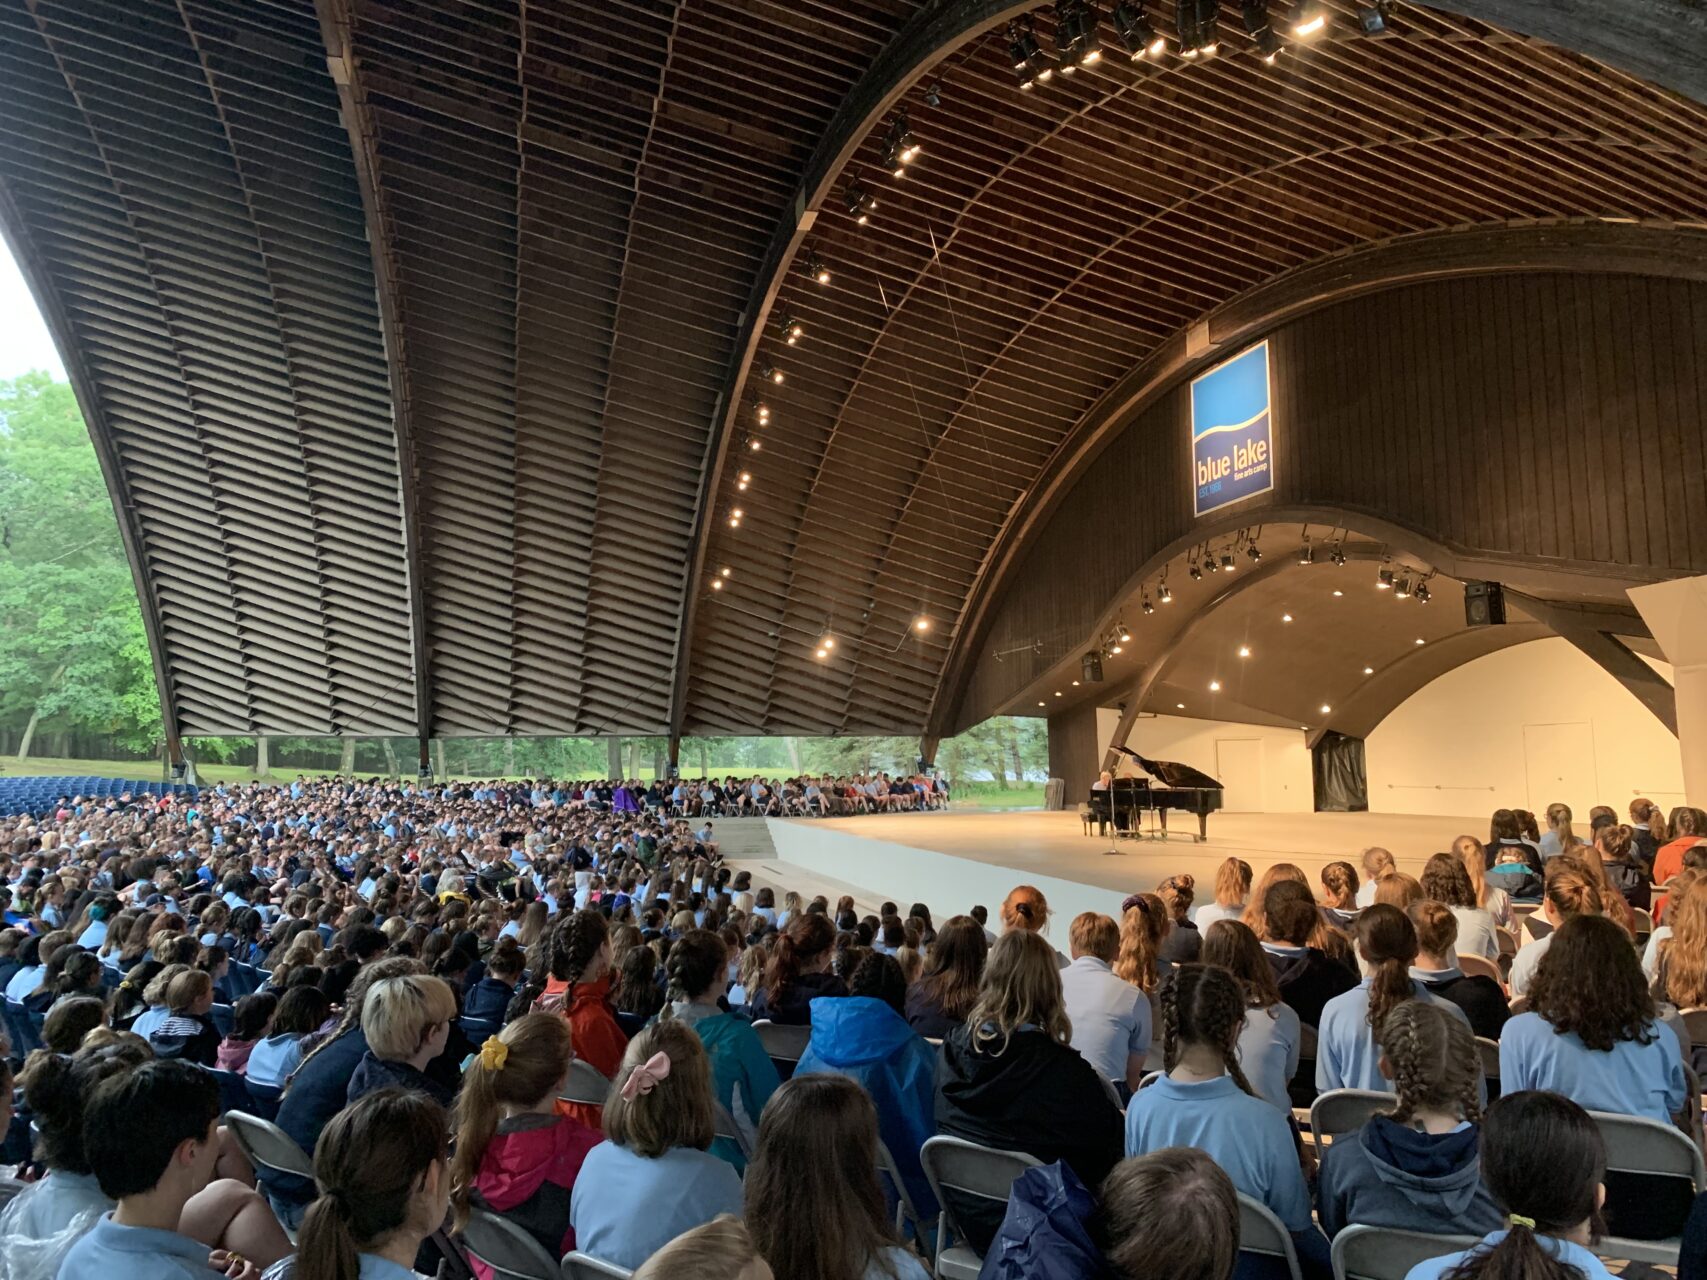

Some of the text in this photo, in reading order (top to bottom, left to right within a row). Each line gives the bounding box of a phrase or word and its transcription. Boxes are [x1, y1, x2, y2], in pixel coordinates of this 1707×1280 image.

[1198, 438, 1267, 486] blue lake
[1244, 467, 1253, 477] arts
